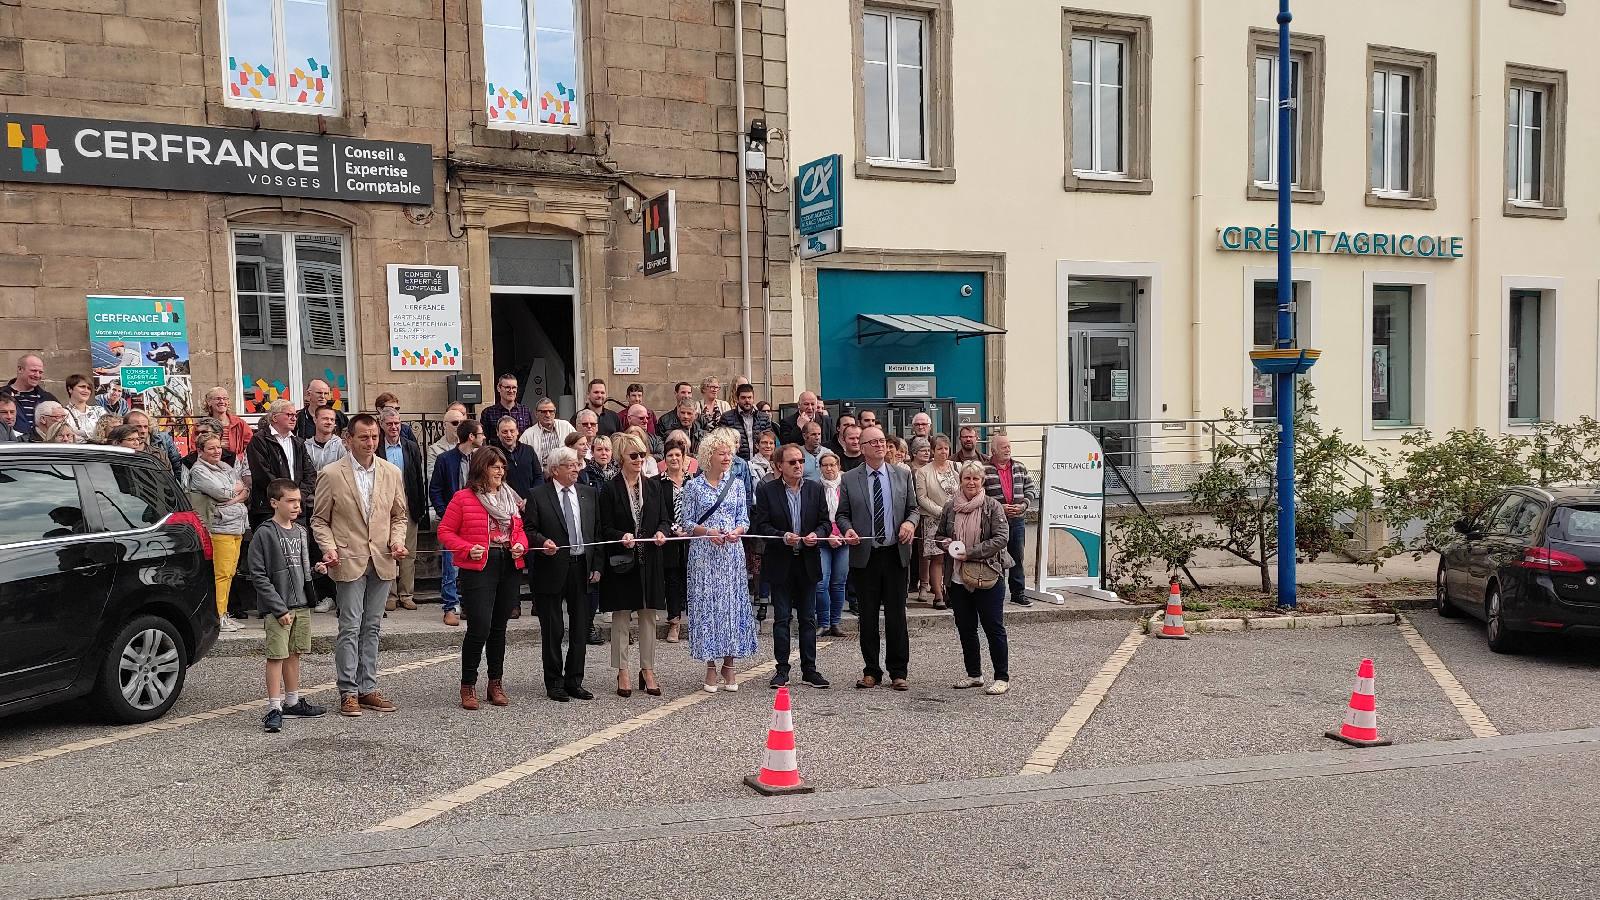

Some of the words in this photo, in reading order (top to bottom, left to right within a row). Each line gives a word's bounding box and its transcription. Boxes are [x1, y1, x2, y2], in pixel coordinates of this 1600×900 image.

[74, 128, 319, 172] CERFRANCE
[344, 145, 394, 161] Conseil
[398, 152, 406, 162] &
[345, 162, 408, 178] Expertise
[248, 173, 320, 188] VOSGES
[346, 178, 421, 194] Comptable
[1223, 224, 1326, 253] CRÉDIT
[1334, 231, 1463, 258] AGRICOLE
[646, 257, 668, 270] CERFRANCE
[435, 271, 442, 279] &
[94, 313, 160, 323] CERFRANCE
[1052, 462, 1090, 470] CERFRANCE
